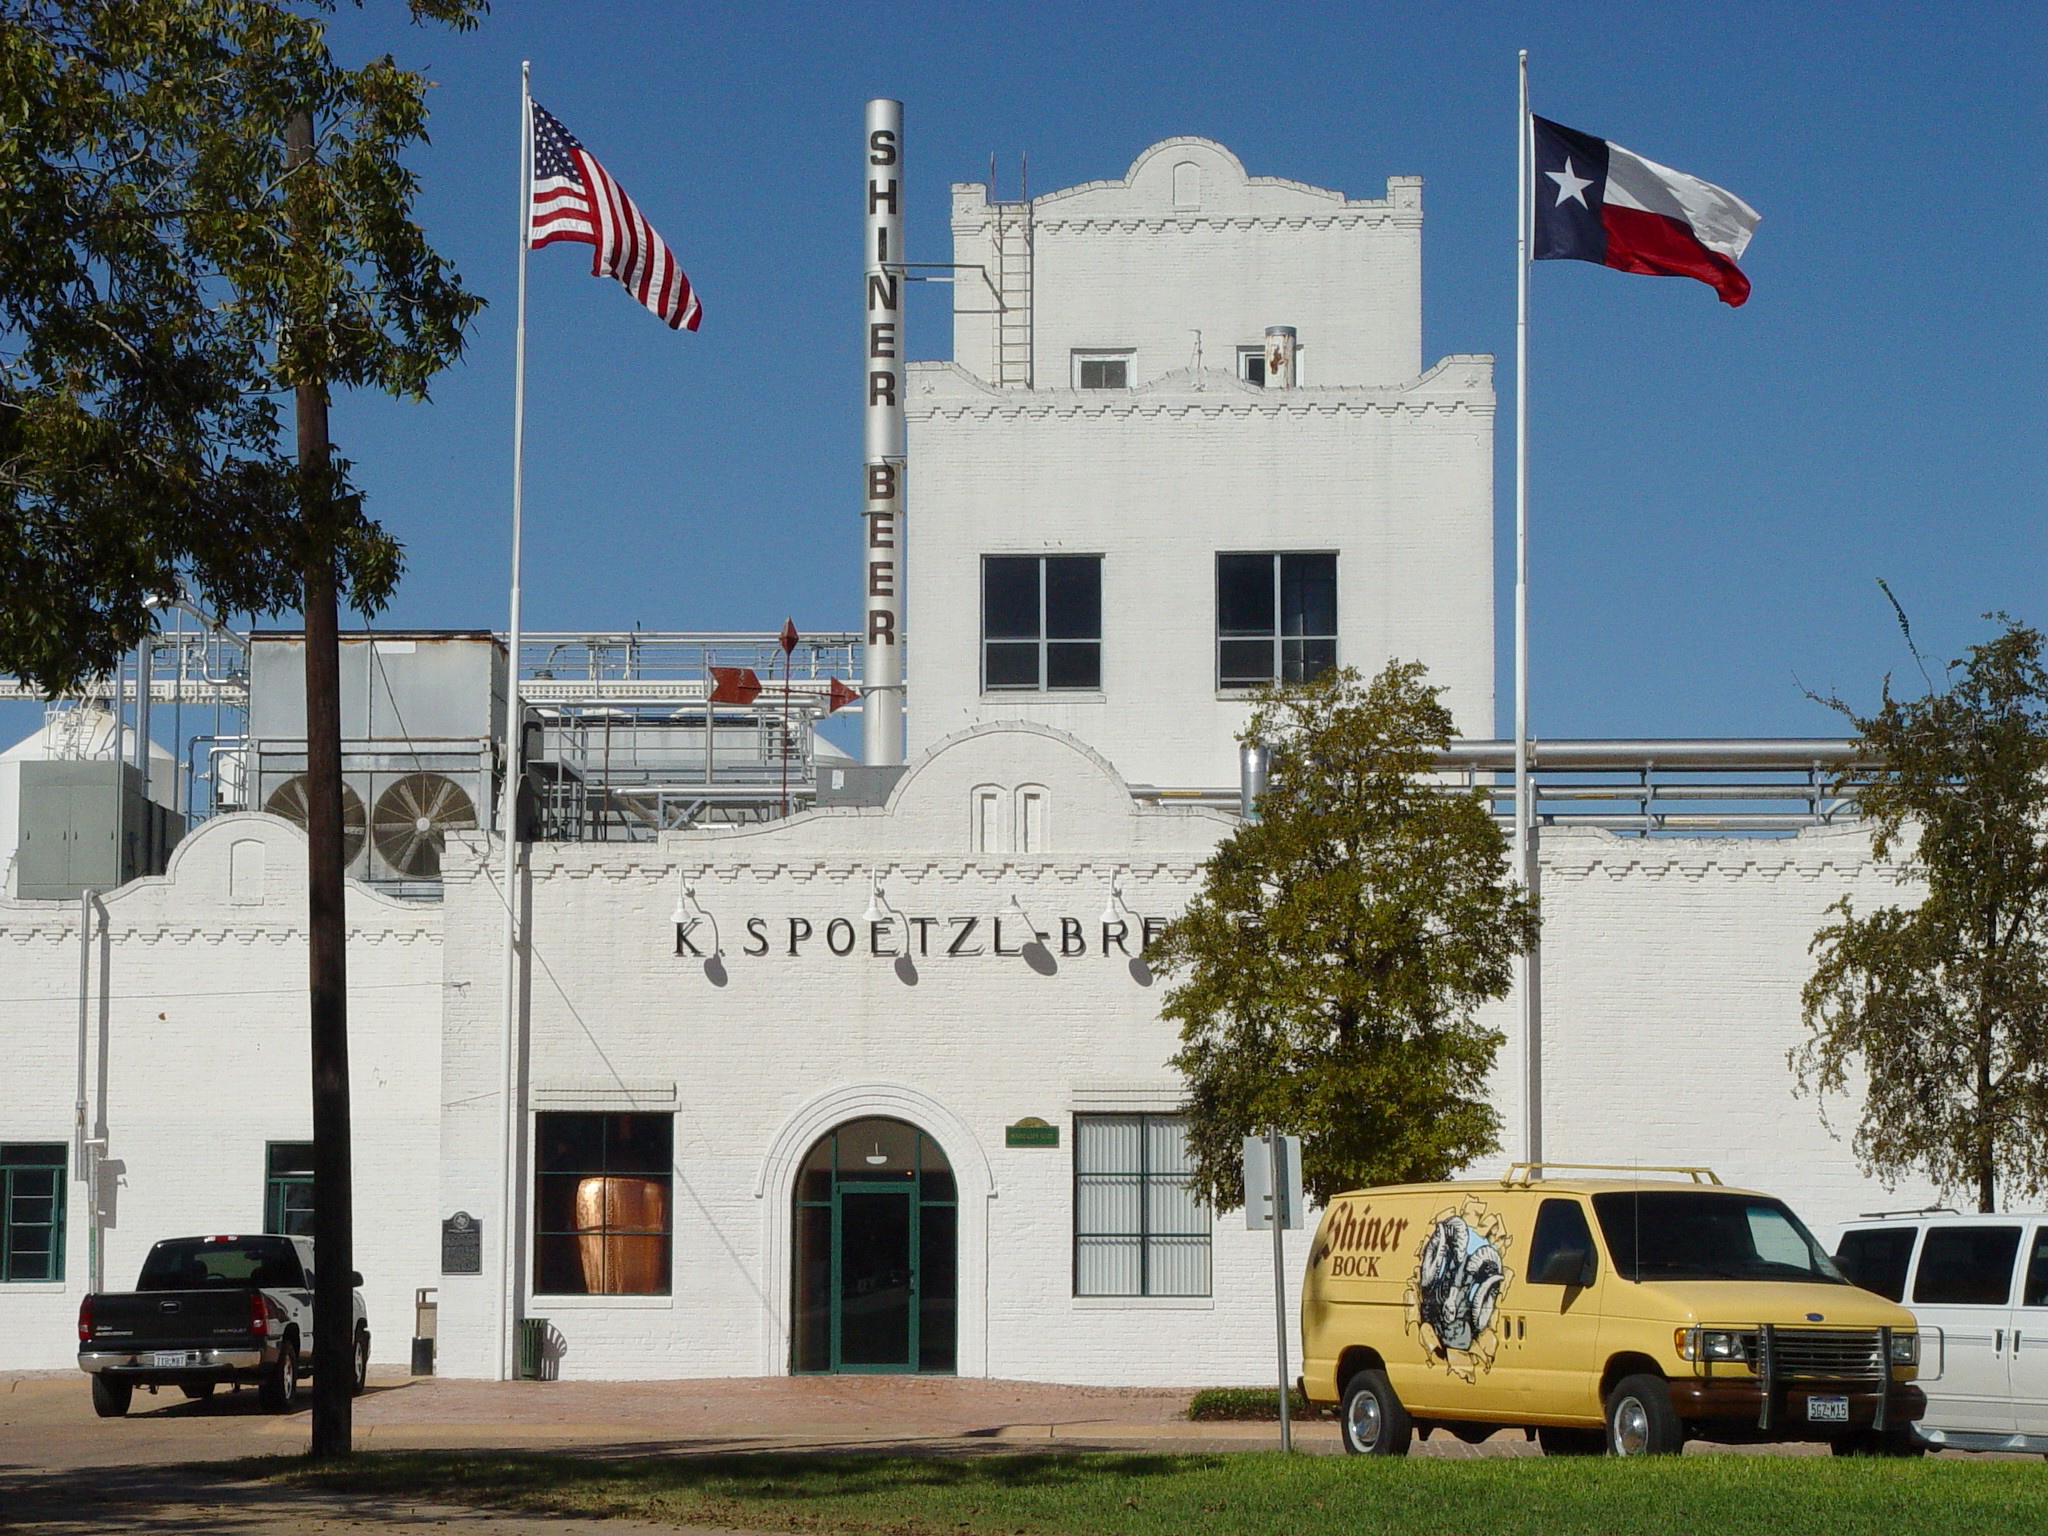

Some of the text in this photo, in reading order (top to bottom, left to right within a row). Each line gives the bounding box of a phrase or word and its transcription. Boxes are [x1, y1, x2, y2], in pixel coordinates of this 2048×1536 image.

[868, 129, 898, 407] SHINER
[868, 464, 897, 646] BEER
[1320, 1201, 1409, 1261] Shiner
[1331, 1255, 1381, 1277] BOCK
